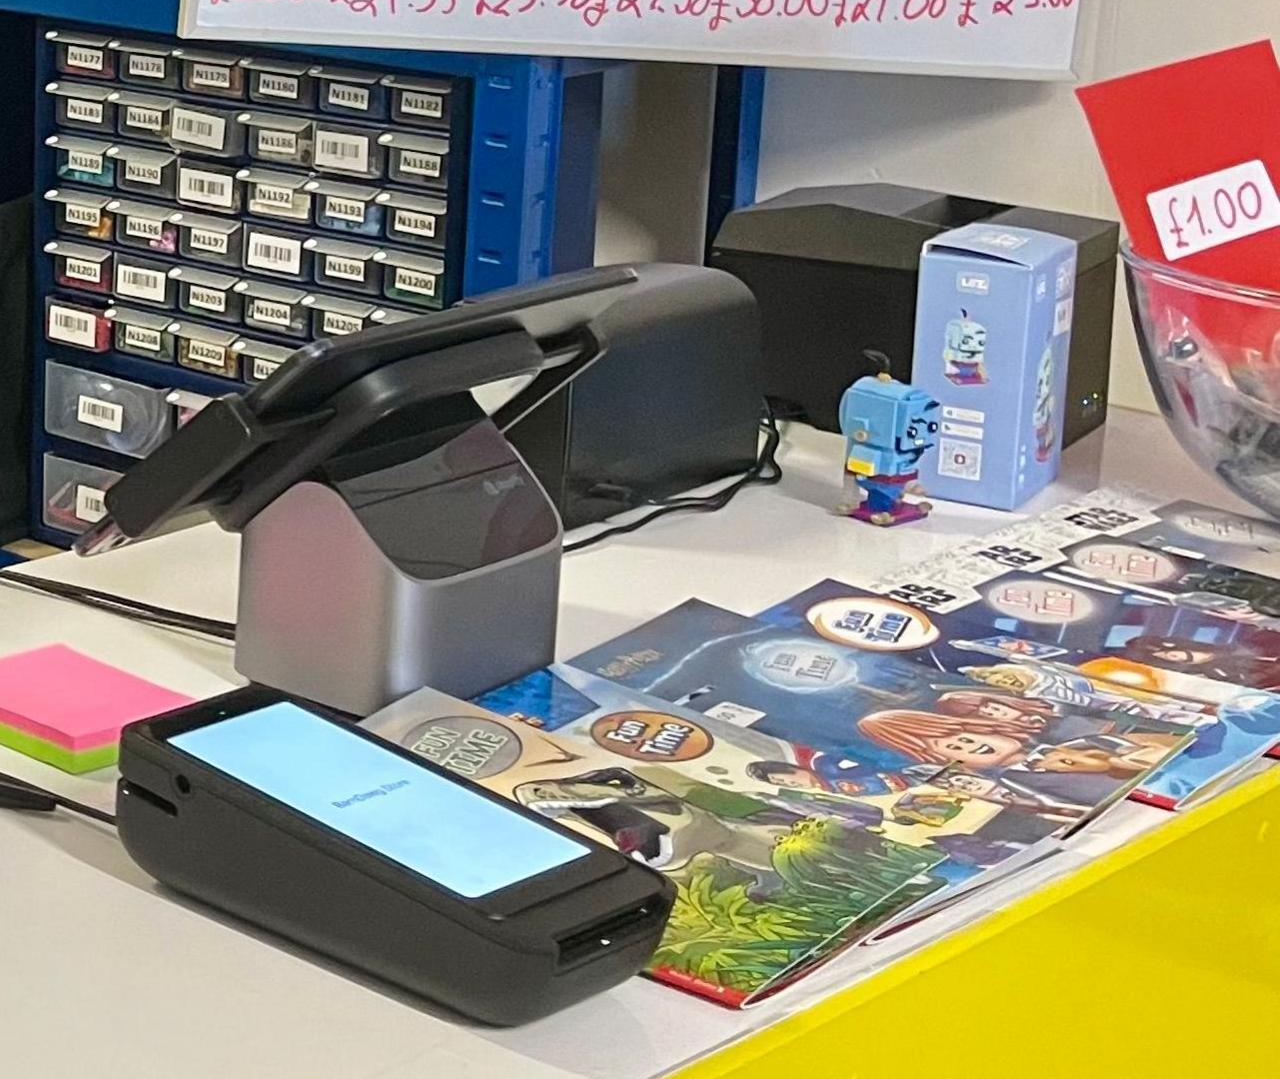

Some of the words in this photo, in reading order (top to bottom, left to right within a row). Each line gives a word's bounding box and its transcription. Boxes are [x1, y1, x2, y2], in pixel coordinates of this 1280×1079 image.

[69, 51, 101, 65] N1177
[131, 60, 162, 73] N1178
[262, 79, 296, 93] N1180
[331, 89, 365, 104] N1181
[404, 96, 440, 111] N1182
[69, 105, 100, 118] N1183
[129, 111, 160, 126] N1184
[261, 135, 294, 149] N1186
[71, 155, 100, 169] N1189
[403, 155, 438, 171] N1188
[127, 165, 159, 180] N1190
[258, 188, 290, 203] N1192
[68, 208, 98, 223] N1195
[328, 201, 362, 217] N1193
[1166, 180, 1262, 249] £1.00
[129, 221, 160, 235] N1196
[397, 215, 433, 231] N1194
[192, 233, 225, 248] N1197
[68, 263, 98, 278] N1201
[328, 261, 362, 276] N1199
[397, 274, 433, 291] N1200
[192, 292, 223, 306] N1203
[255, 305, 288, 320] N1204
[327, 317, 359, 331] N1205
[127, 329, 159, 346] N1208
[191, 346, 223, 361] N1209
[605, 719, 647, 744] Fun
[635, 722, 693, 757] Time
[410, 725, 463, 759] FUN
[440, 727, 510, 777] TIME
